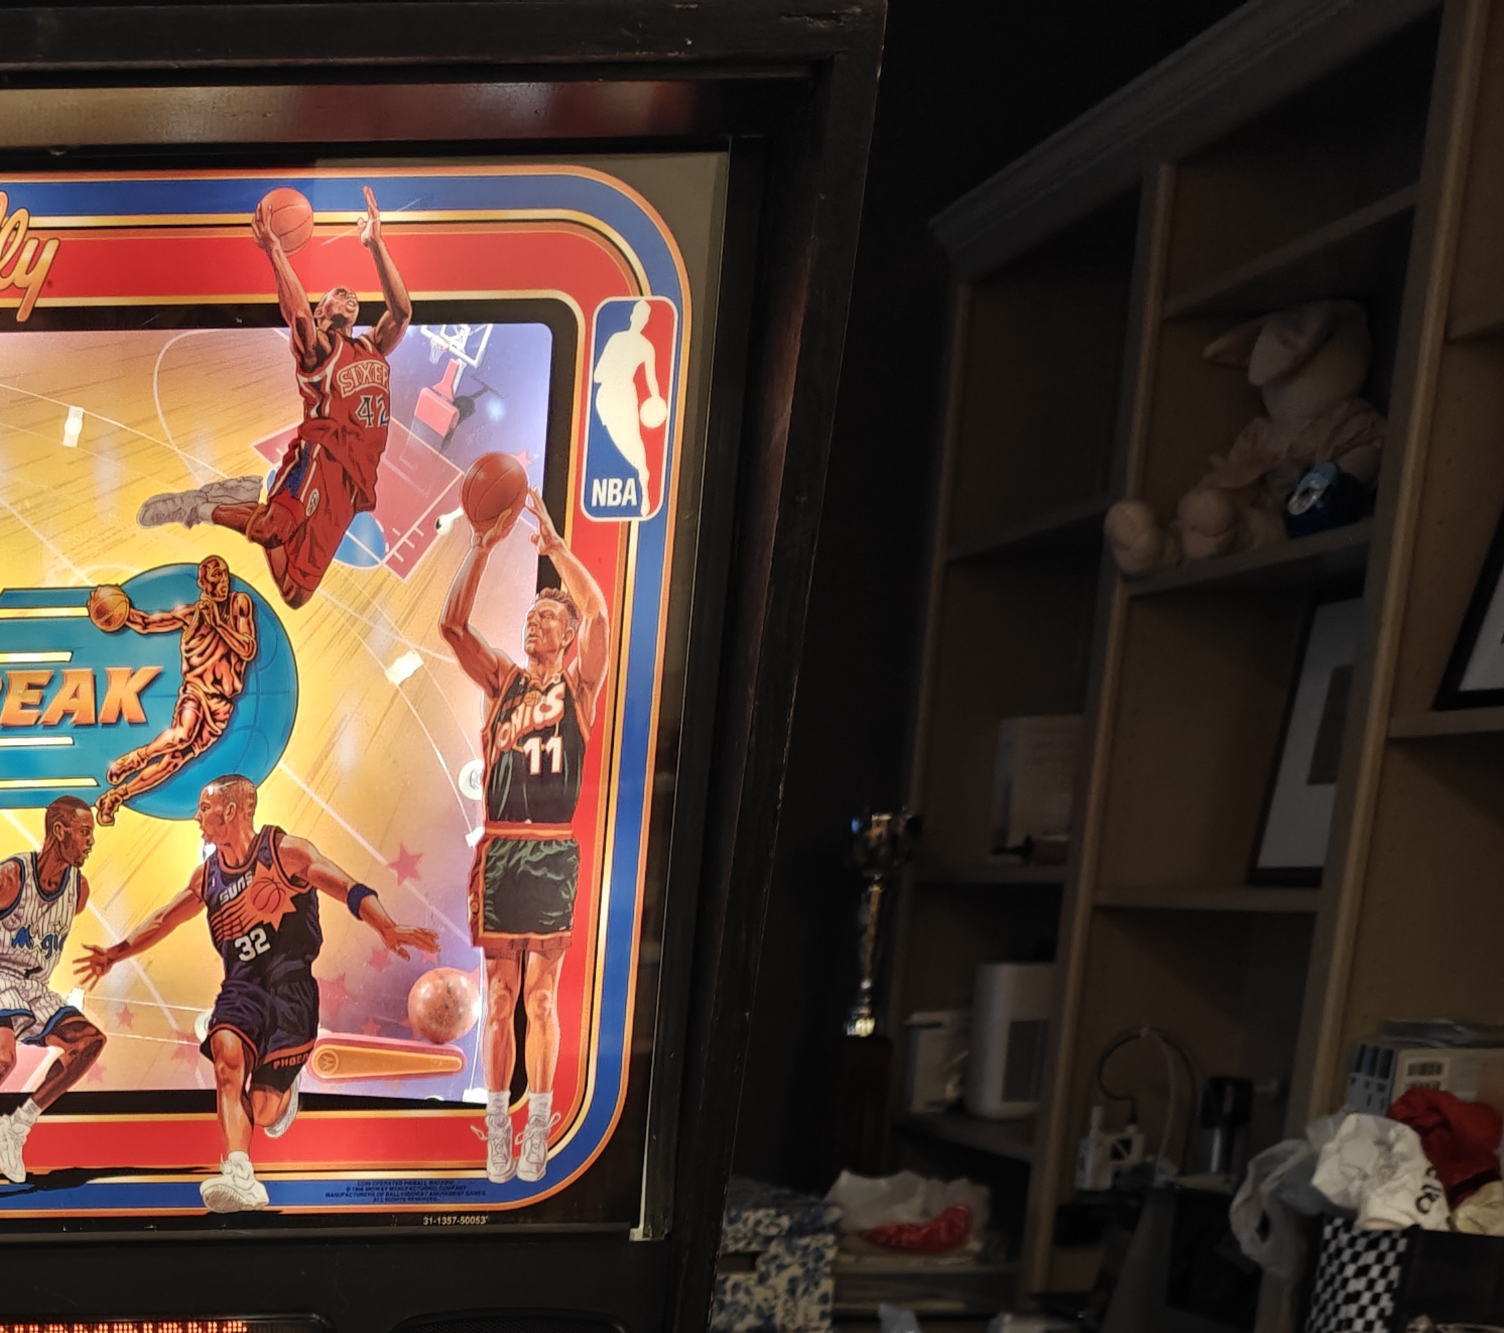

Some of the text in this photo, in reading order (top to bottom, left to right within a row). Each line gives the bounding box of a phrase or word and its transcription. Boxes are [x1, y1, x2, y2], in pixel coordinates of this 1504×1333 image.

[591, 477, 637, 507] NBA
[523, 736, 564, 776] 11
[218, 869, 256, 905] SUNS
[235, 929, 272, 962] 32
